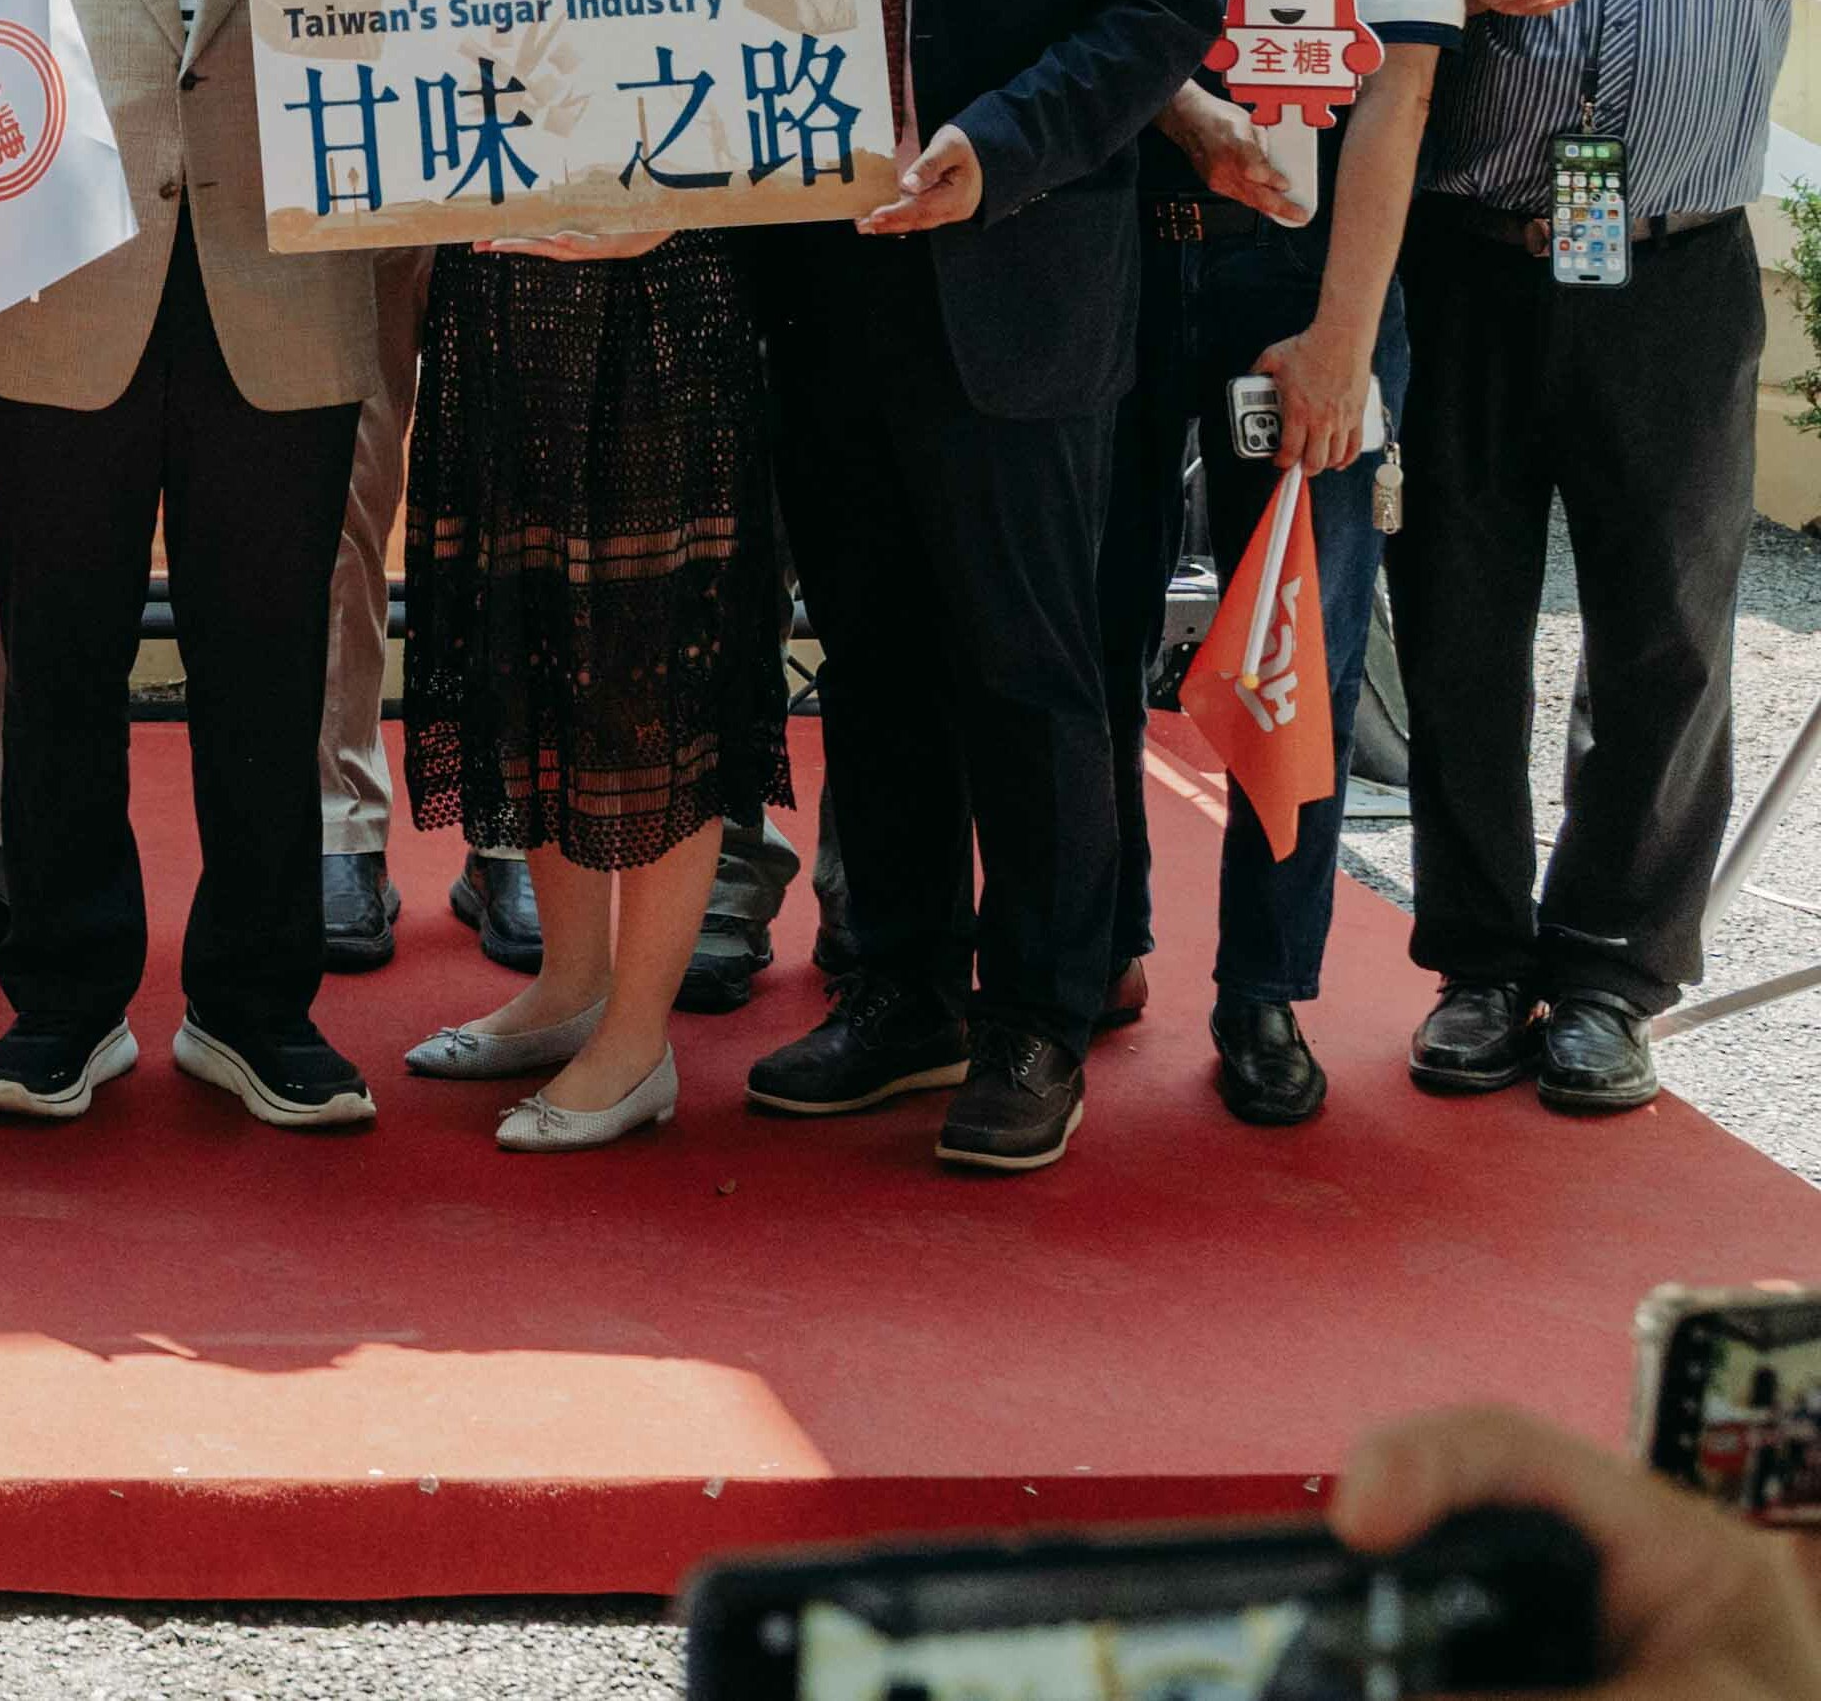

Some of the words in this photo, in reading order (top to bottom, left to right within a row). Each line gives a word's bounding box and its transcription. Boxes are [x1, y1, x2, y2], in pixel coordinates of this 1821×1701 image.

[1249, 37, 1331, 74] 全糖
[284, 57, 540, 216] 甘味
[616, 32, 861, 190] 之路
